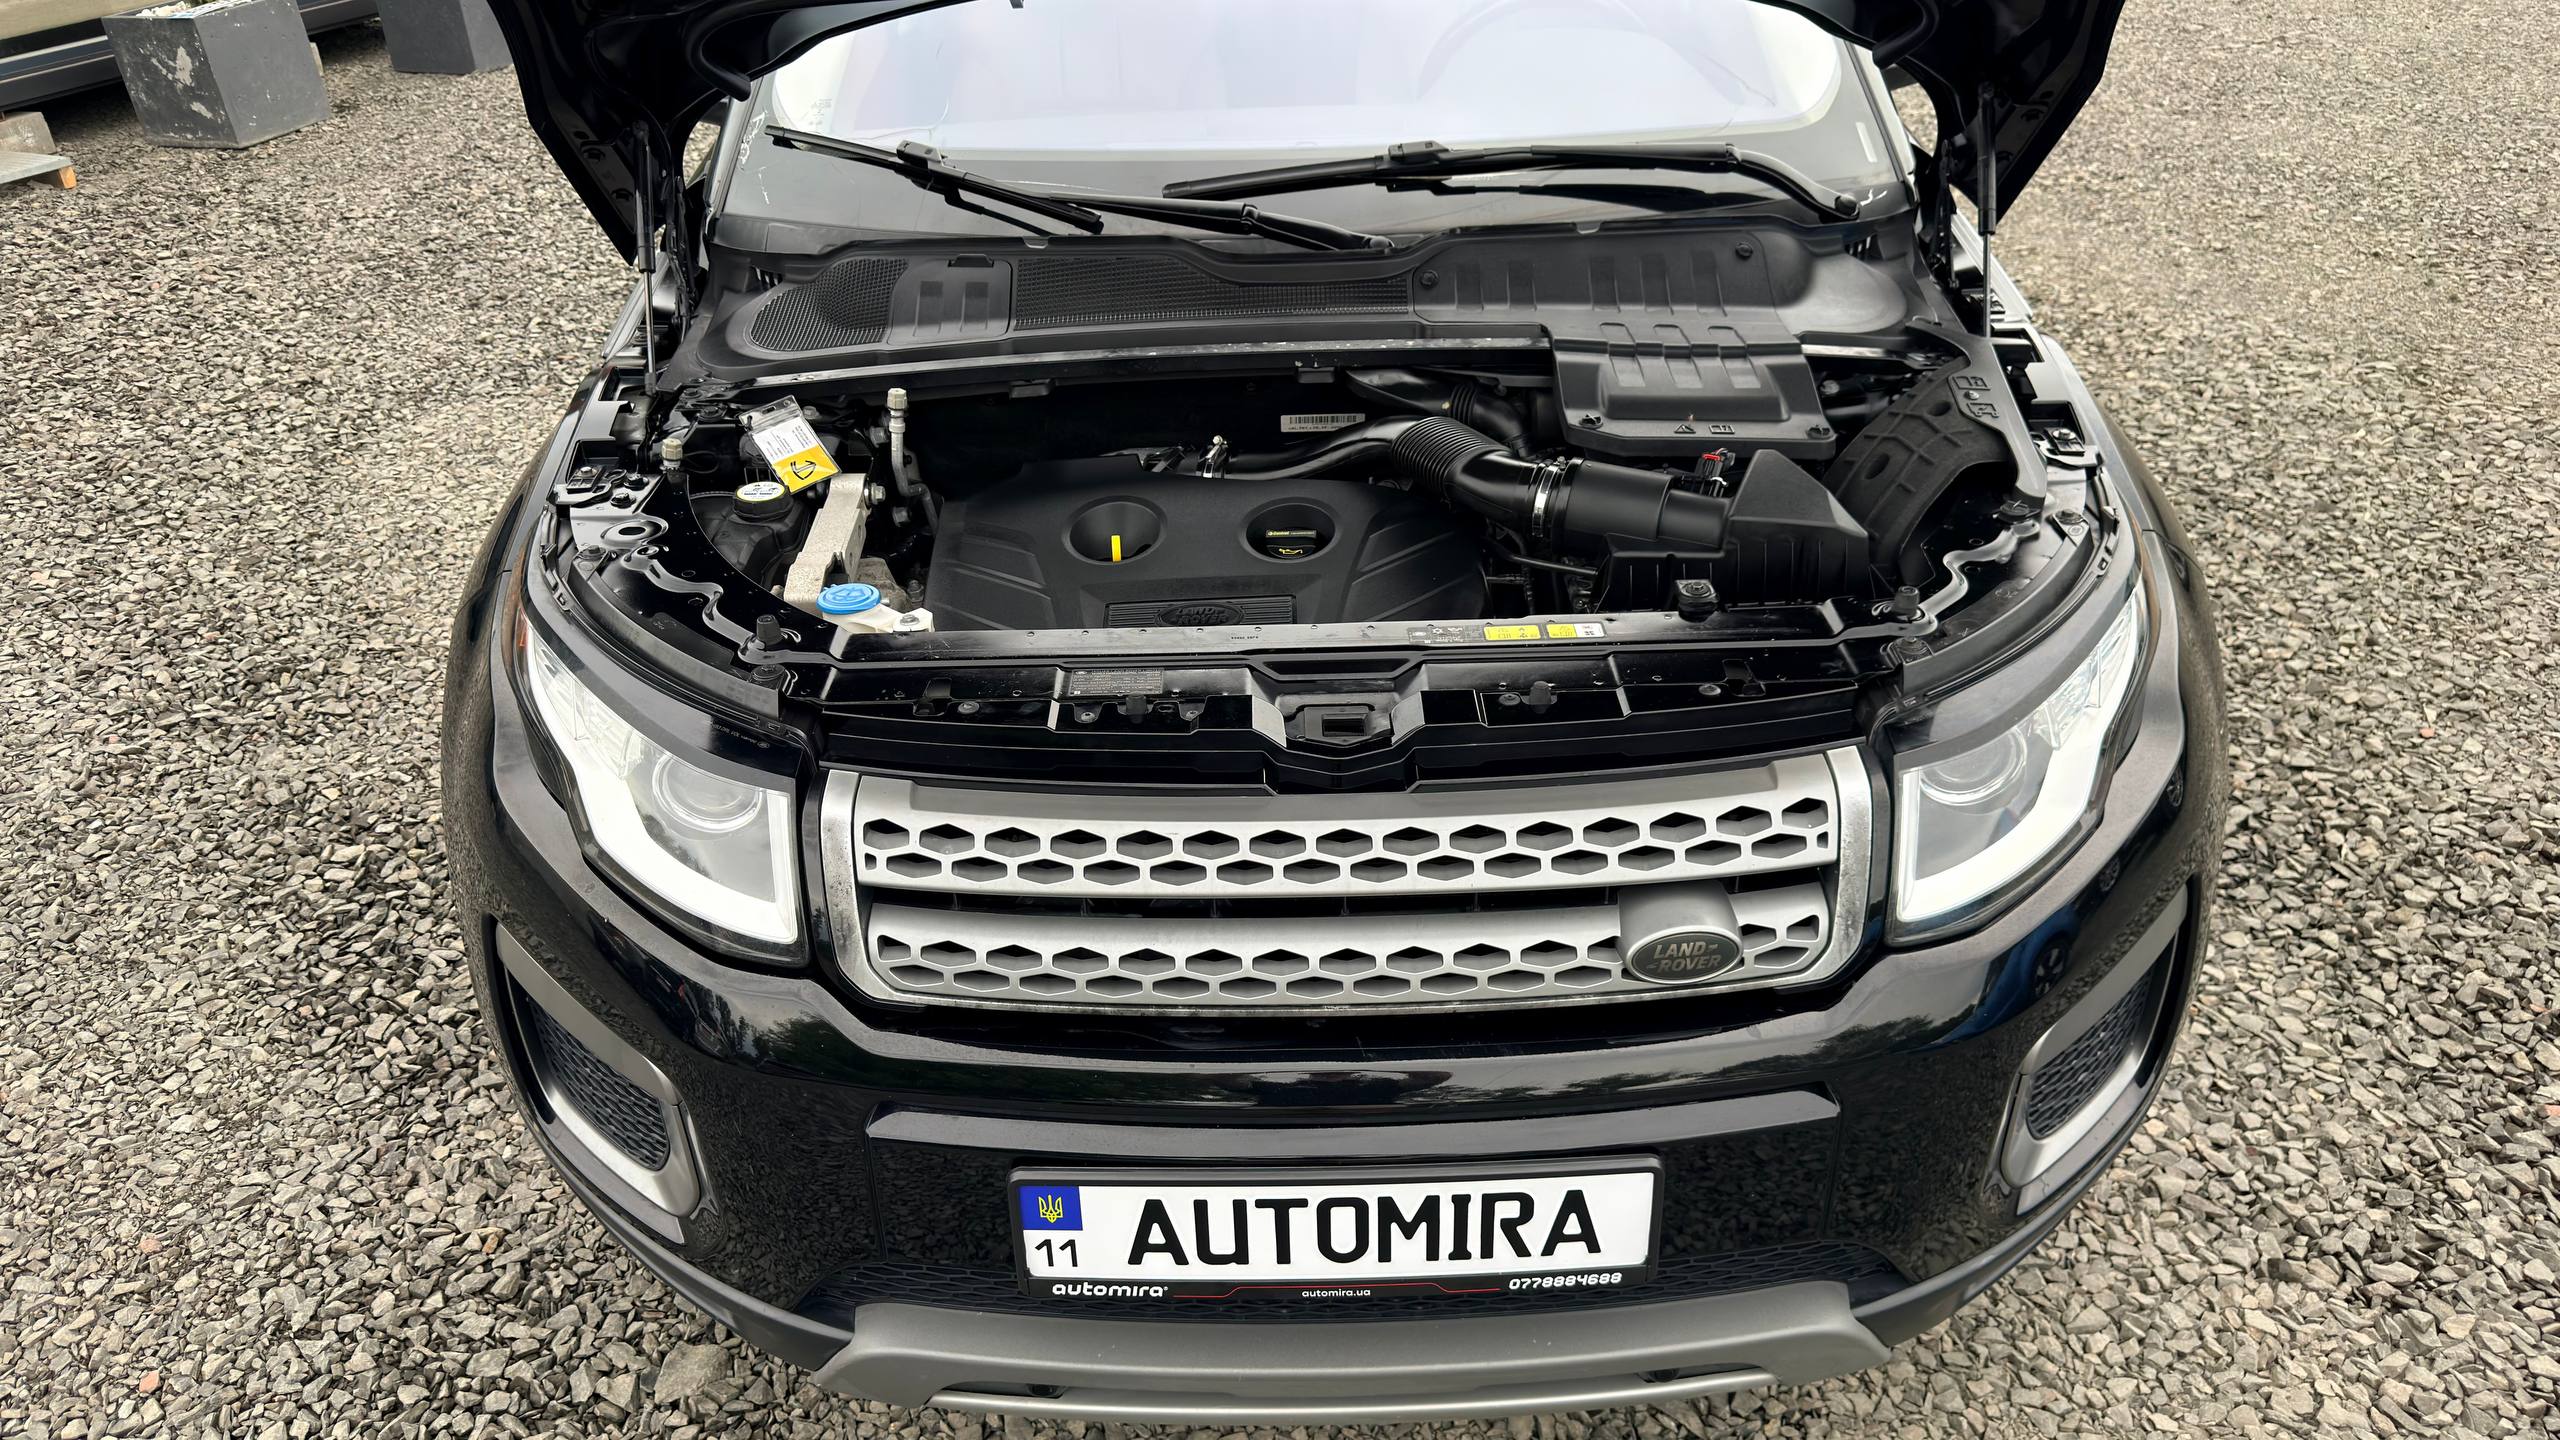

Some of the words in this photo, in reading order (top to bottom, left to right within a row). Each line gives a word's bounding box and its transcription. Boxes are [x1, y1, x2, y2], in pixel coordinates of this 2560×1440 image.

[1034, 1238, 1079, 1268] 11
[1127, 1189, 1602, 1266] AUTOMIRA
[1301, 1288, 1372, 1298] automira.ua
[1508, 1272, 1623, 1290] 0778884688
